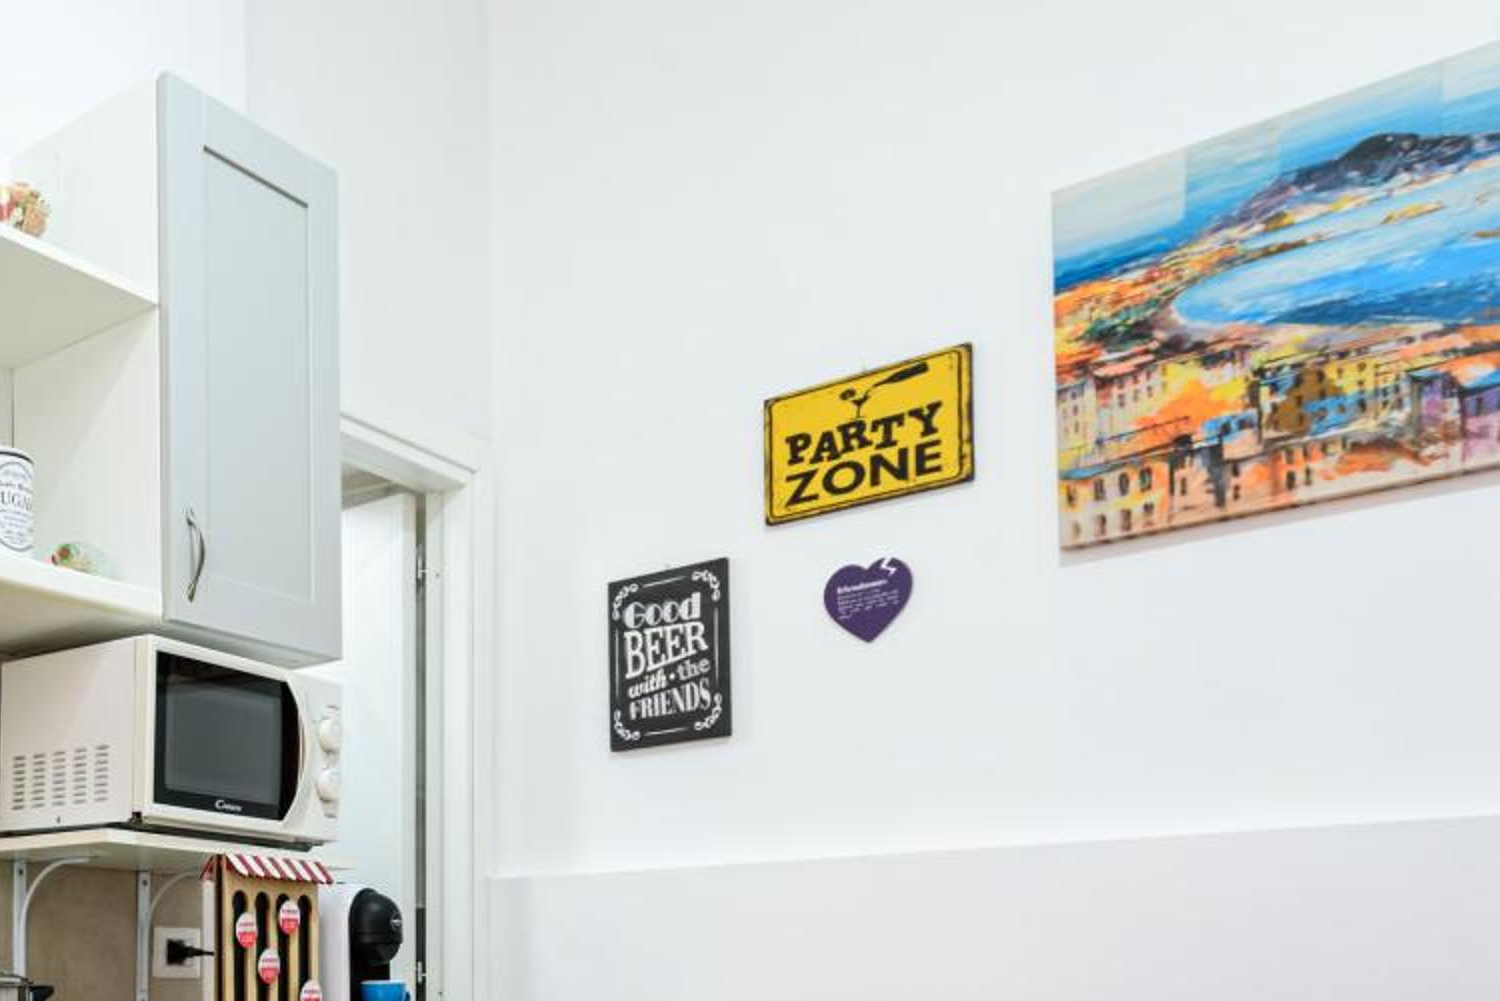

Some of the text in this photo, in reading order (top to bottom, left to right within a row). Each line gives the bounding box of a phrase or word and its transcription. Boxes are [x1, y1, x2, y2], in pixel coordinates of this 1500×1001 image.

[785, 401, 942, 467] PARTY
[785, 440, 942, 506] ZONE
[624, 591, 701, 629] Good
[623, 621, 709, 680] BEER
[627, 658, 710, 699] with the
[629, 677, 711, 721] FRIENDS
